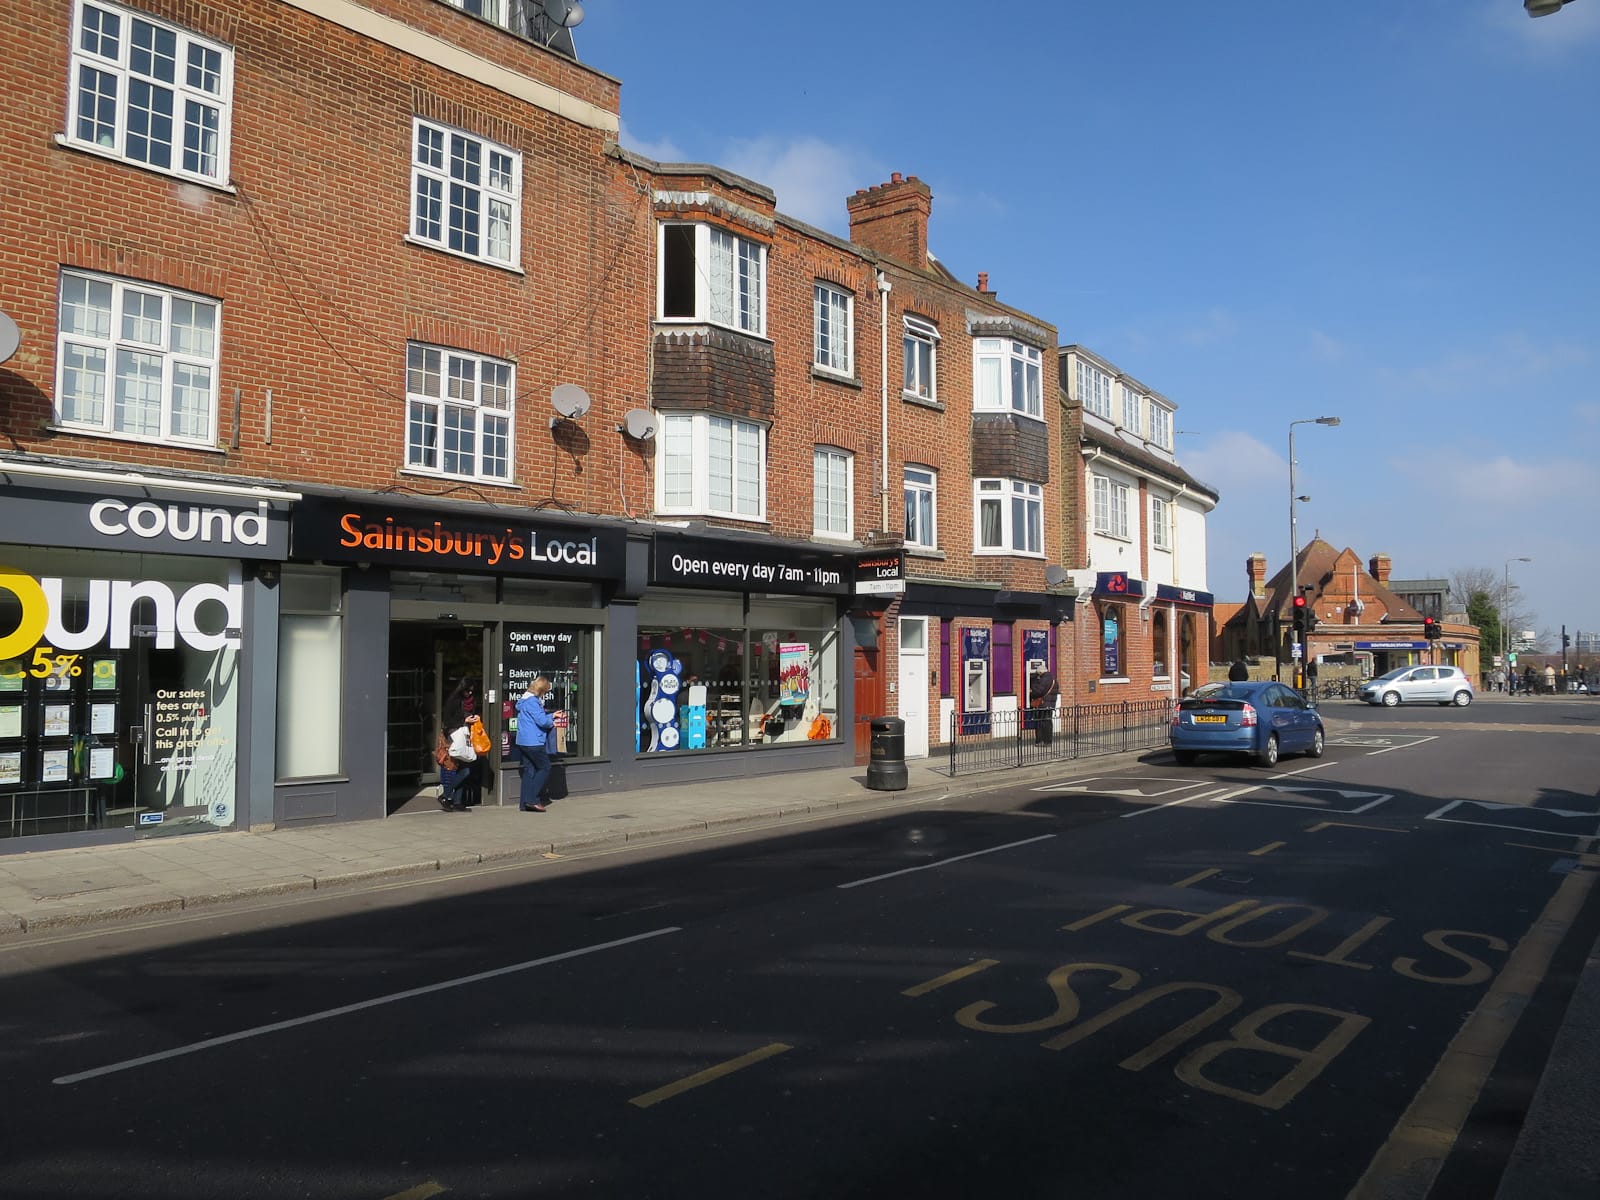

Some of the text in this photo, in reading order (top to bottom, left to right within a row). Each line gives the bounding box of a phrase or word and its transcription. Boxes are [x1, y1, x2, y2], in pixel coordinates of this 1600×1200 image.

[89, 498, 268, 546] cound
[340, 513, 597, 566] Sainsbury's Local
[671, 554, 709, 575] Open
[712, 561, 750, 581] every
[752, 562, 776, 583] day
[777, 564, 804, 582] 7am
[813, 567, 840, 586] 11pm
[876, 566, 899, 578] Local
[509, 631, 572, 643] Open every day
[510, 643, 529, 652] 7am
[536, 643, 555, 653] 11pm
[509, 669, 538, 679] Bakery
[509, 680, 528, 690] Fruit
[156, 688, 206, 699] Our sales
[156, 702, 199, 711] fees are
[156, 713, 180, 723] 0.5%
[155, 727, 177, 737] Call
[180, 727, 189, 736] in
[191, 727, 202, 736] to
[155, 740, 174, 749] this
[176, 739, 204, 750] great
[1119, 898, 1509, 986] STOP
[954, 961, 1372, 1110] BUS
